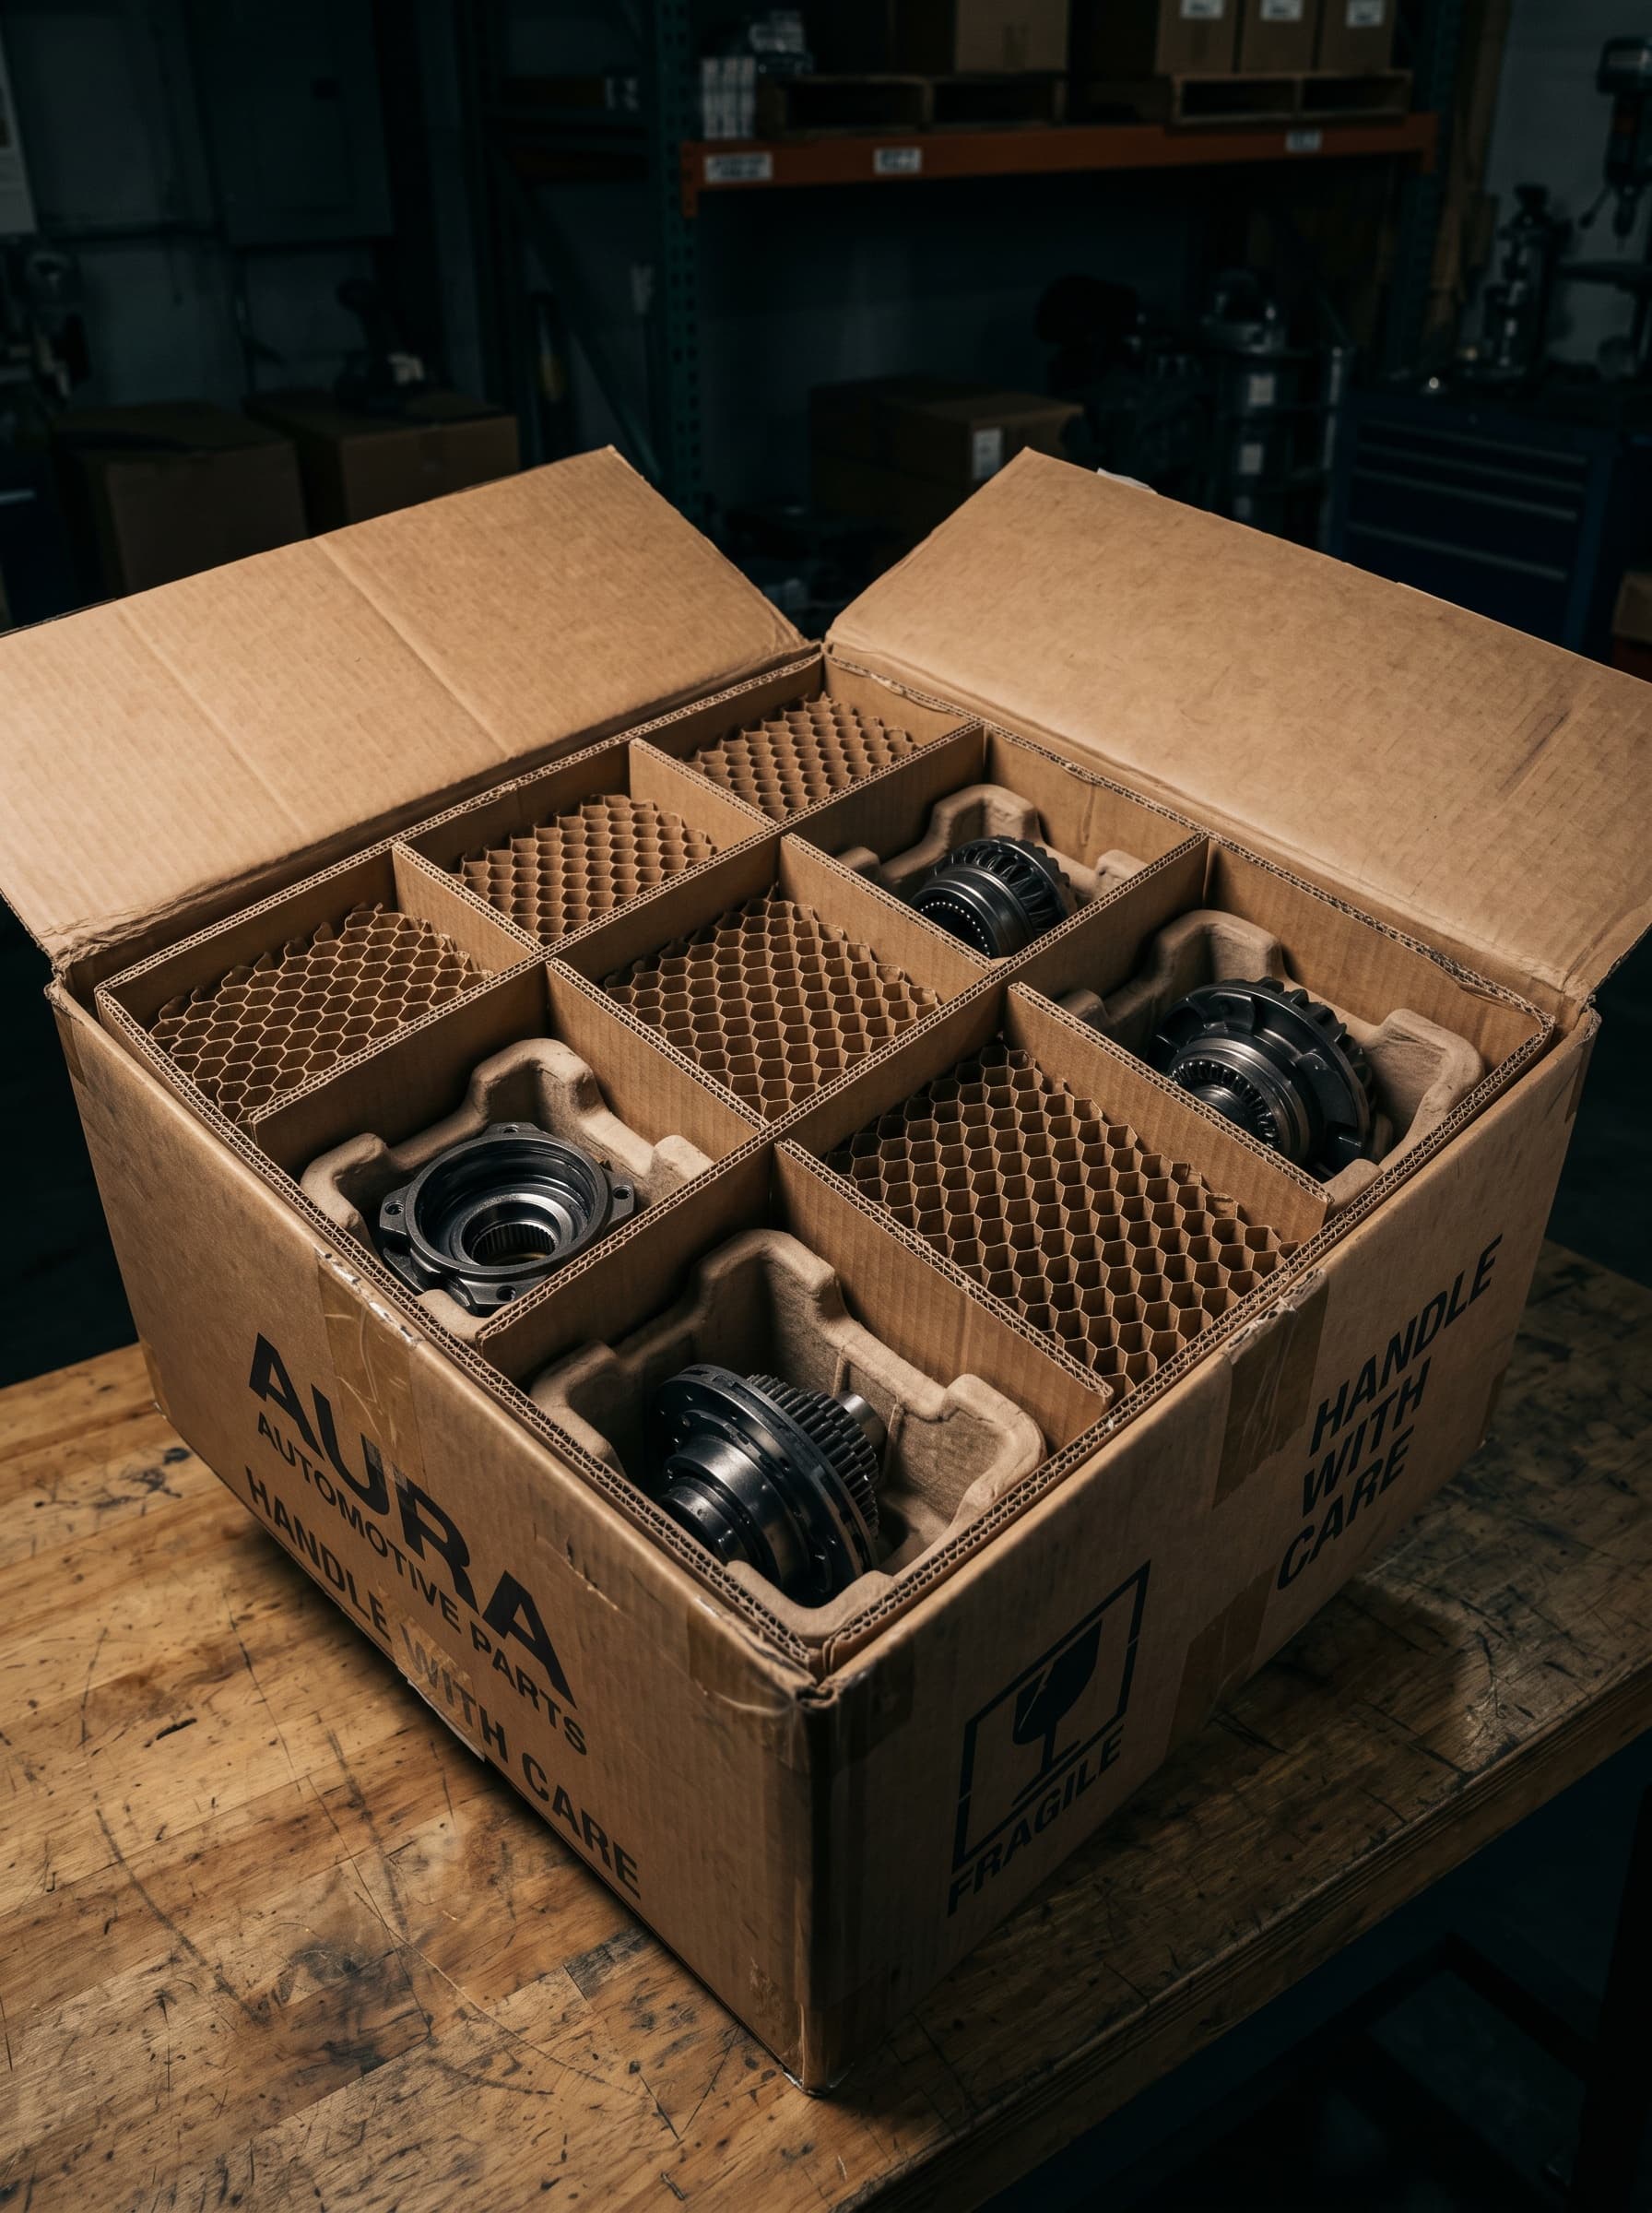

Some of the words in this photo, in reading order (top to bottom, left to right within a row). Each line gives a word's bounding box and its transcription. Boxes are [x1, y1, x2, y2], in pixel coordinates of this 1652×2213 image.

[1302, 1357, 1431, 1518] WITH
[1309, 1235, 1503, 1457] HANDLE
[249, 1333, 577, 1710] AURA
[258, 1411, 460, 1634] AUTOMOTIVE
[471, 1622, 587, 1756] PARTS
[1277, 1426, 1414, 1590] CARE
[245, 1465, 391, 1642] HANDLE
[400, 1623, 509, 1762] WITH
[522, 1753, 641, 1899] CARE
[947, 1724, 1124, 1917] FRAGILE
